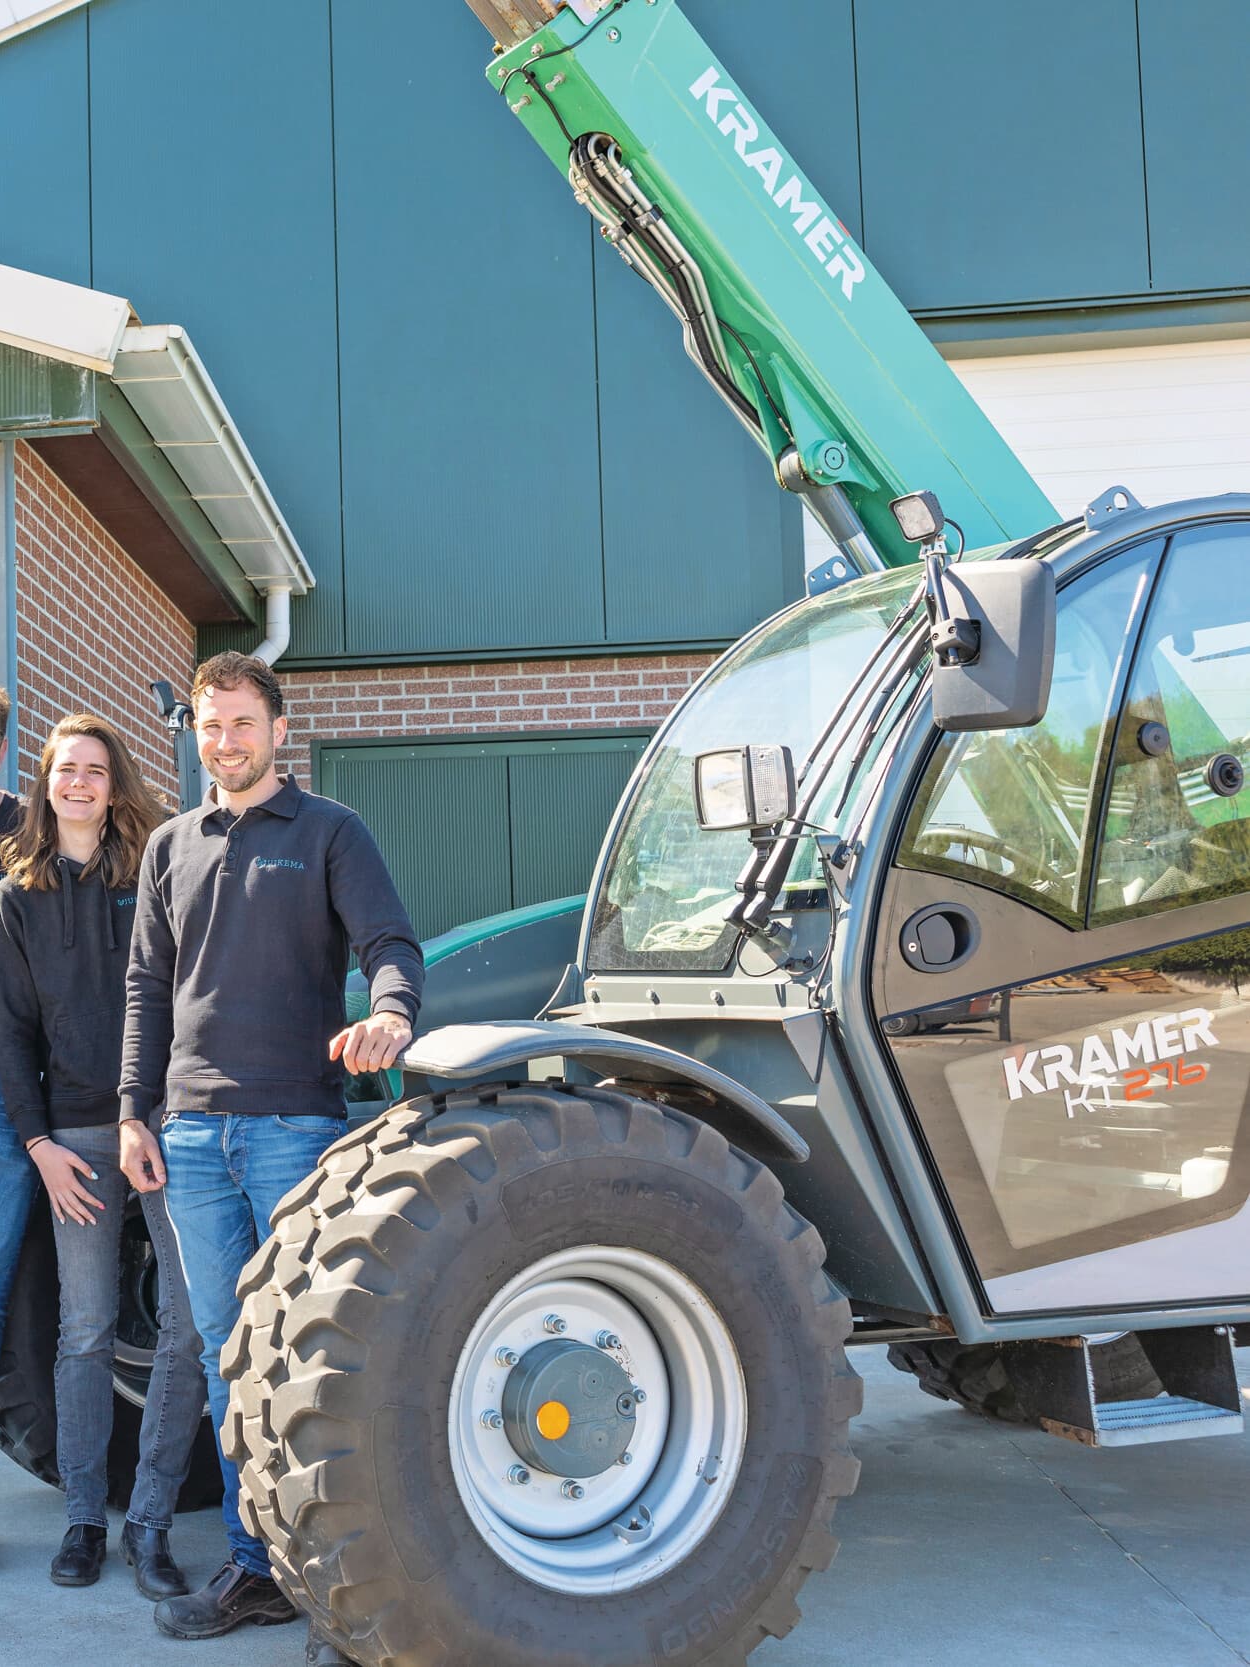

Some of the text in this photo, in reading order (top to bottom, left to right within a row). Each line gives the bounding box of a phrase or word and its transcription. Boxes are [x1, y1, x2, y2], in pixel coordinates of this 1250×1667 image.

[688, 65, 866, 303] KRAMER
[1002, 1007, 1220, 1101] KRAMER
[1063, 1057, 1208, 1119] KT 276
